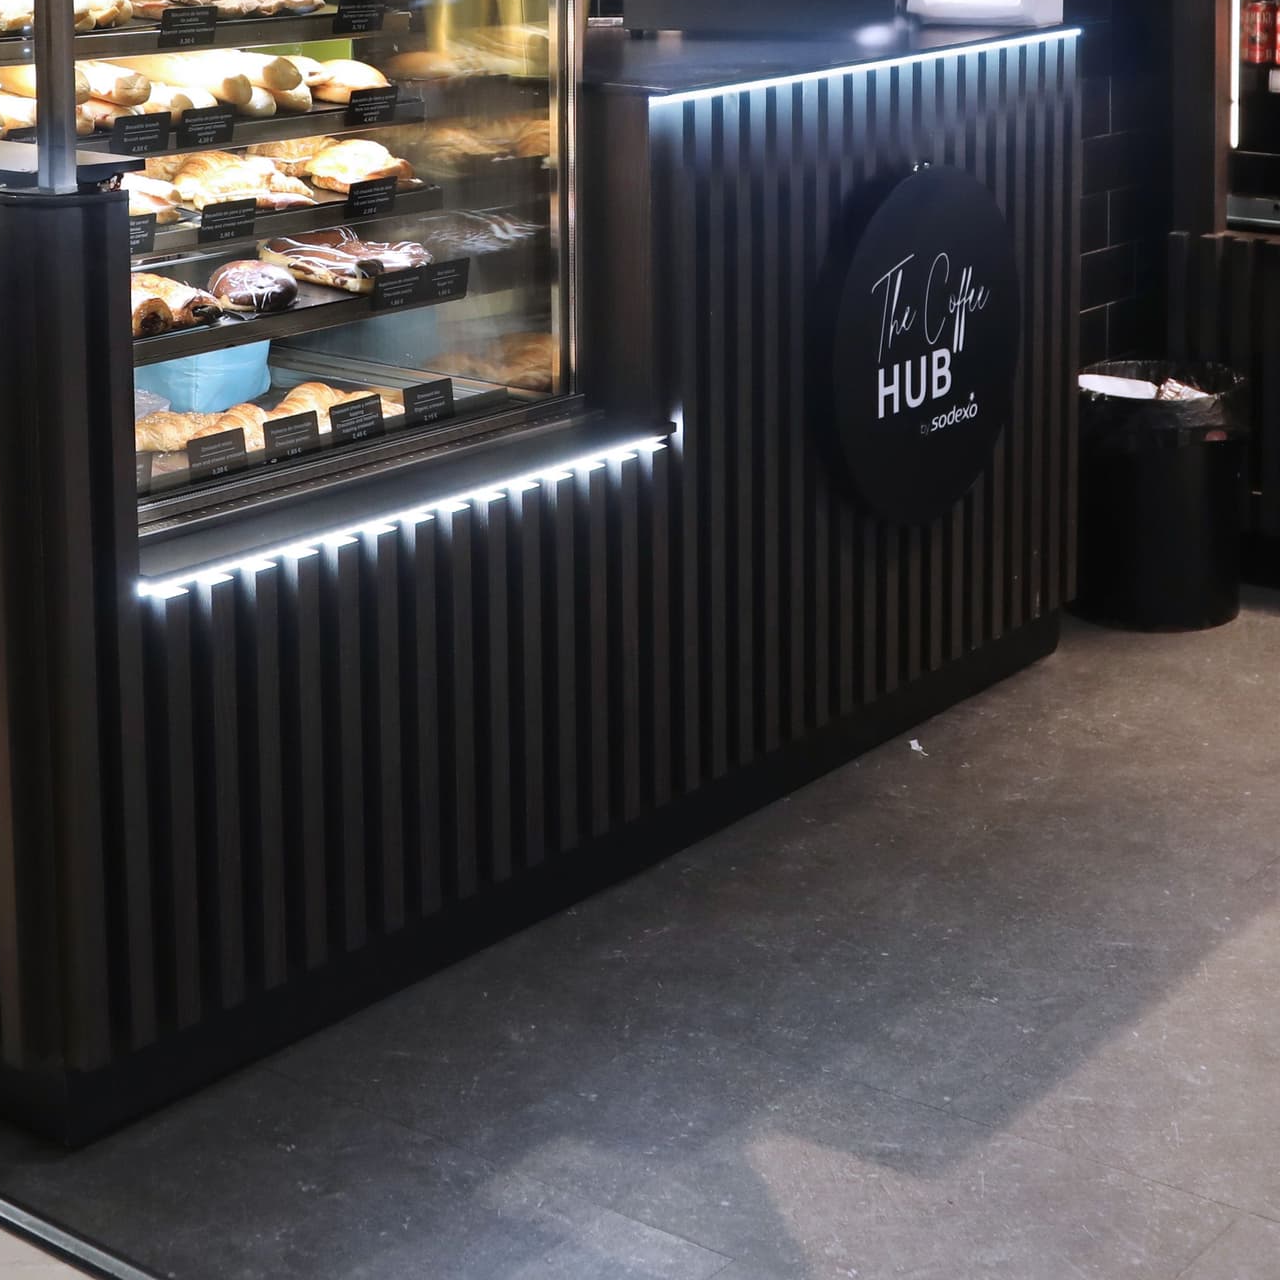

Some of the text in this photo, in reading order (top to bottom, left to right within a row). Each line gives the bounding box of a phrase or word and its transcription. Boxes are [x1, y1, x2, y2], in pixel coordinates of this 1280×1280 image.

[871, 252, 990, 363] The Coffee
[877, 348, 953, 420] HUB
[930, 395, 978, 432] sodexo
